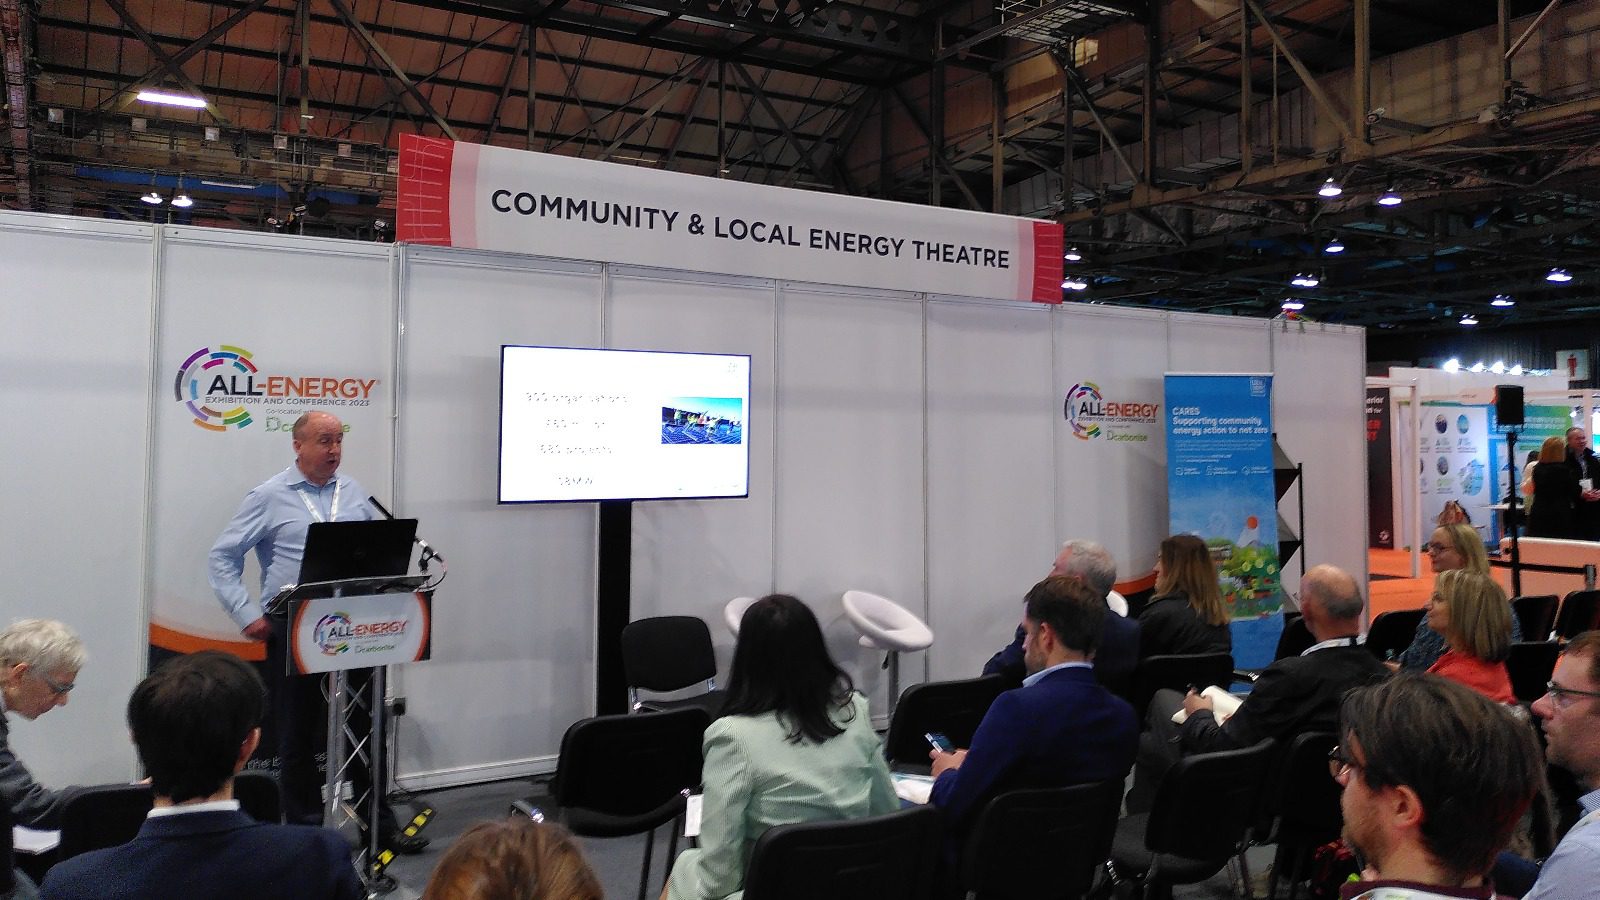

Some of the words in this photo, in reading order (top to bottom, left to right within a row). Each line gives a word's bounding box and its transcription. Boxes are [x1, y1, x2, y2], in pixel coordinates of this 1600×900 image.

[491, 189, 679, 232] COMMUNITY
[688, 213, 705, 235] &
[714, 216, 801, 247] LOCAL
[809, 228, 905, 258] ENERGY
[911, 239, 1010, 269] THEATRE
[206, 374, 376, 399] ALL-ENERGY
[204, 396, 261, 405] EXHIBITION
[263, 397, 284, 405] AND
[286, 398, 347, 406] CONFERENCE
[349, 399, 370, 407] 2023
[1079, 402, 1159, 418] ALL-ENERGY
[1172, 407, 1200, 416] CARES
[1172, 416, 1217, 427] Supporting
[1218, 416, 1262, 427] community
[1172, 427, 1202, 436] energy
[1202, 426, 1227, 434] action
[328, 620, 408, 639] ALL-ENERGY
